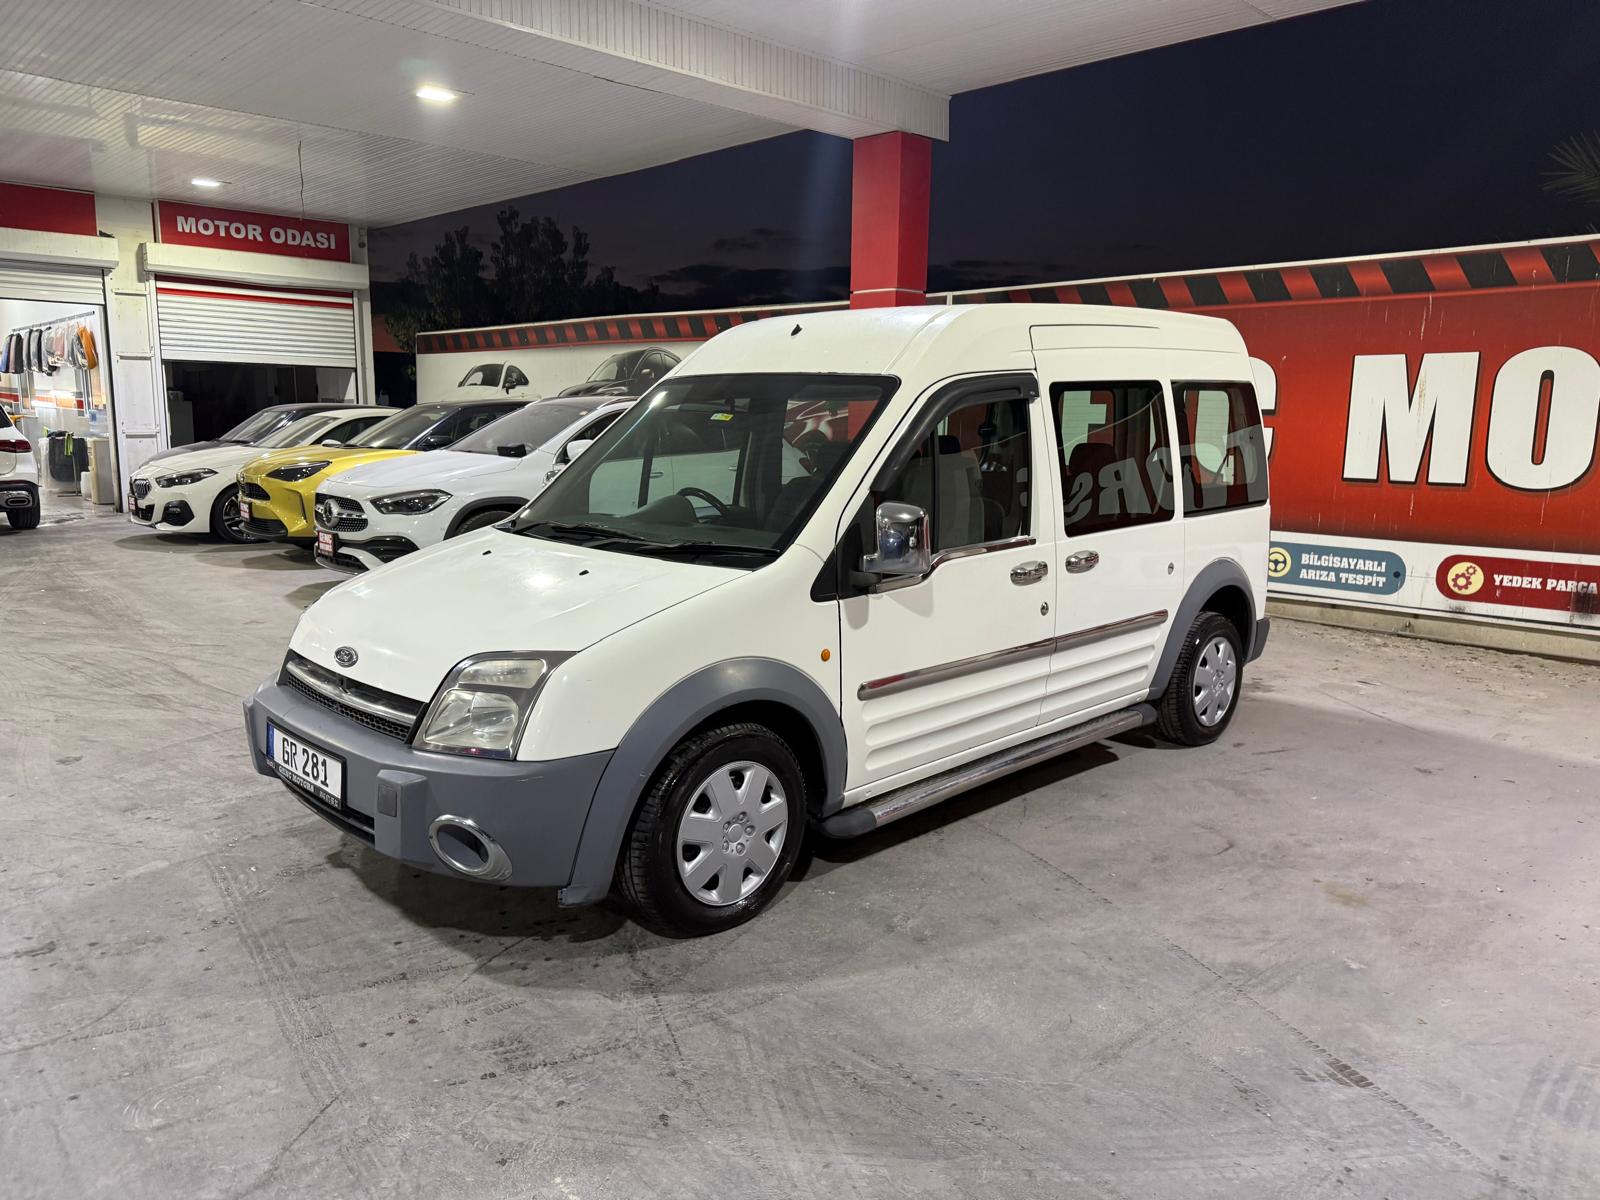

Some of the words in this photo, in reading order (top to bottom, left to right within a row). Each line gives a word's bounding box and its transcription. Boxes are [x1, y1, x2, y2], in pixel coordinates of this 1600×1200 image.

[176, 215, 264, 242] MOTOR
[269, 227, 337, 250] ODASI
[1342, 345, 1600, 490] MO
[1299, 568, 1336, 583] ARIZA
[1339, 573, 1387, 588] TESPİT
[1493, 574, 1543, 590] YEDEK
[282, 736, 298, 771] GR
[302, 747, 329, 788] 281
